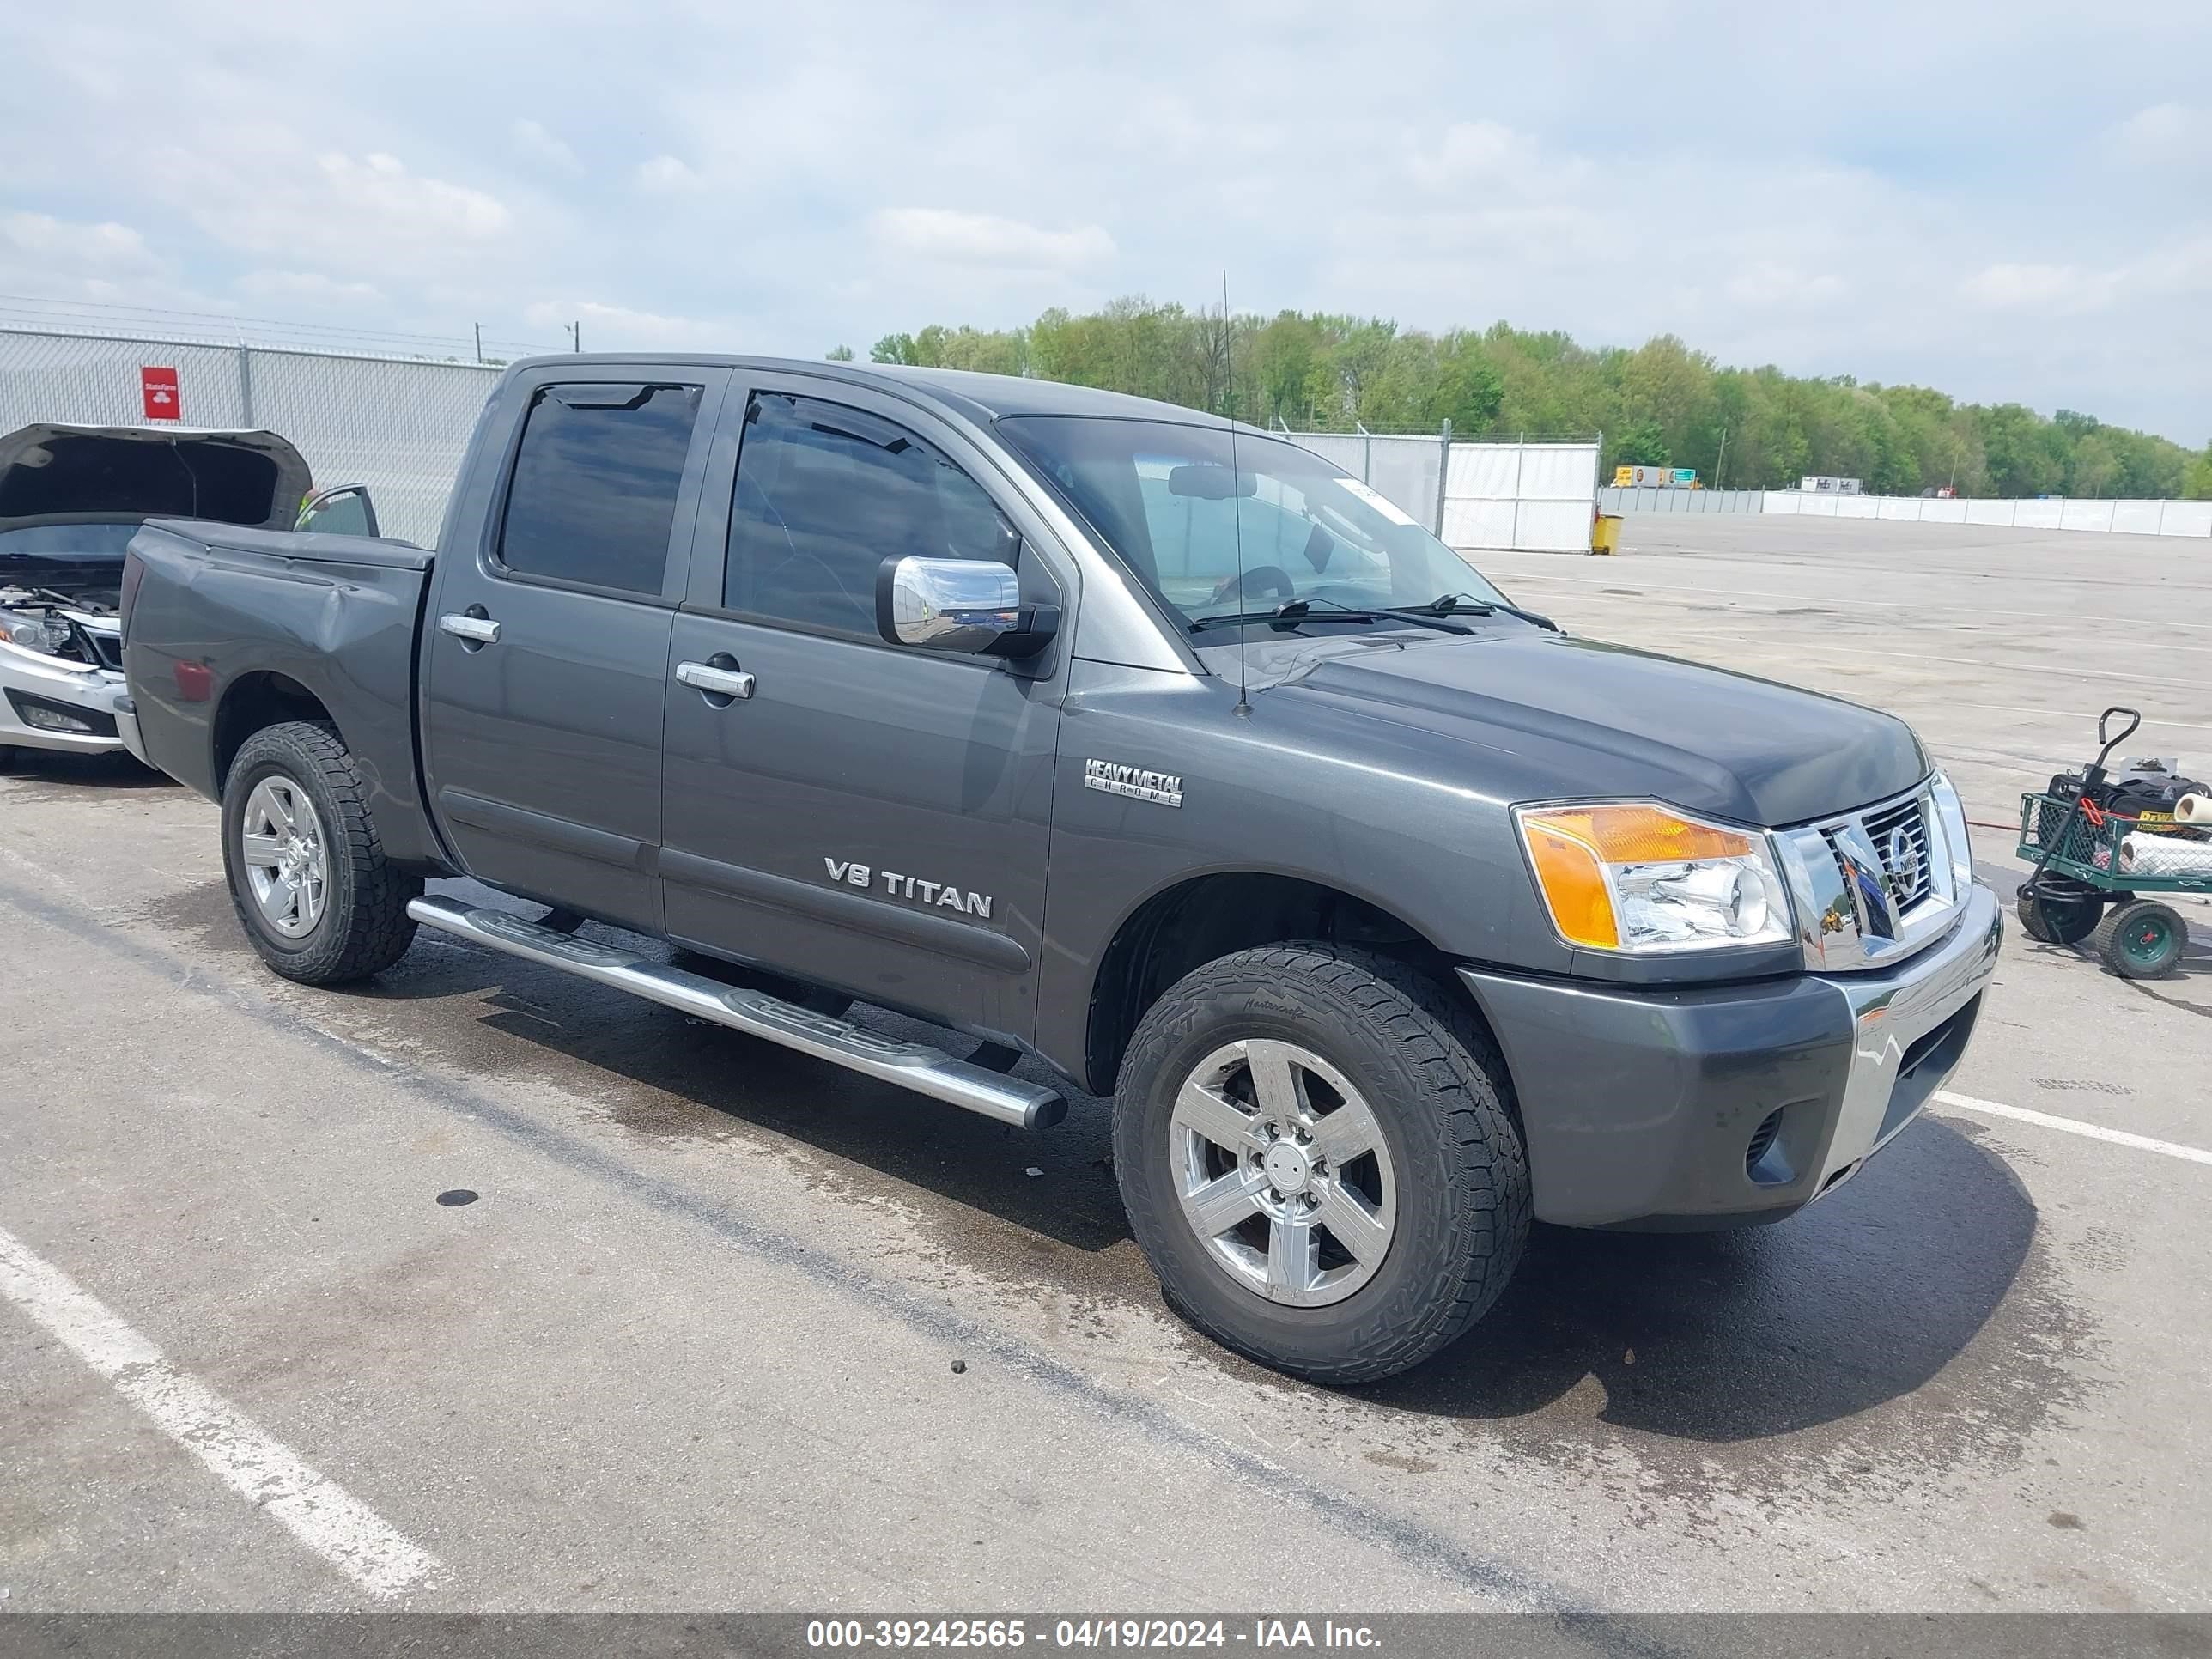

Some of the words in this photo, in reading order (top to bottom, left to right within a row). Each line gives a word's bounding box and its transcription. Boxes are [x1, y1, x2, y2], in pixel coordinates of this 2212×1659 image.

[1090, 777, 1176, 804] CHROME
[823, 857, 871, 889] V8
[881, 870, 994, 919] TITAN
